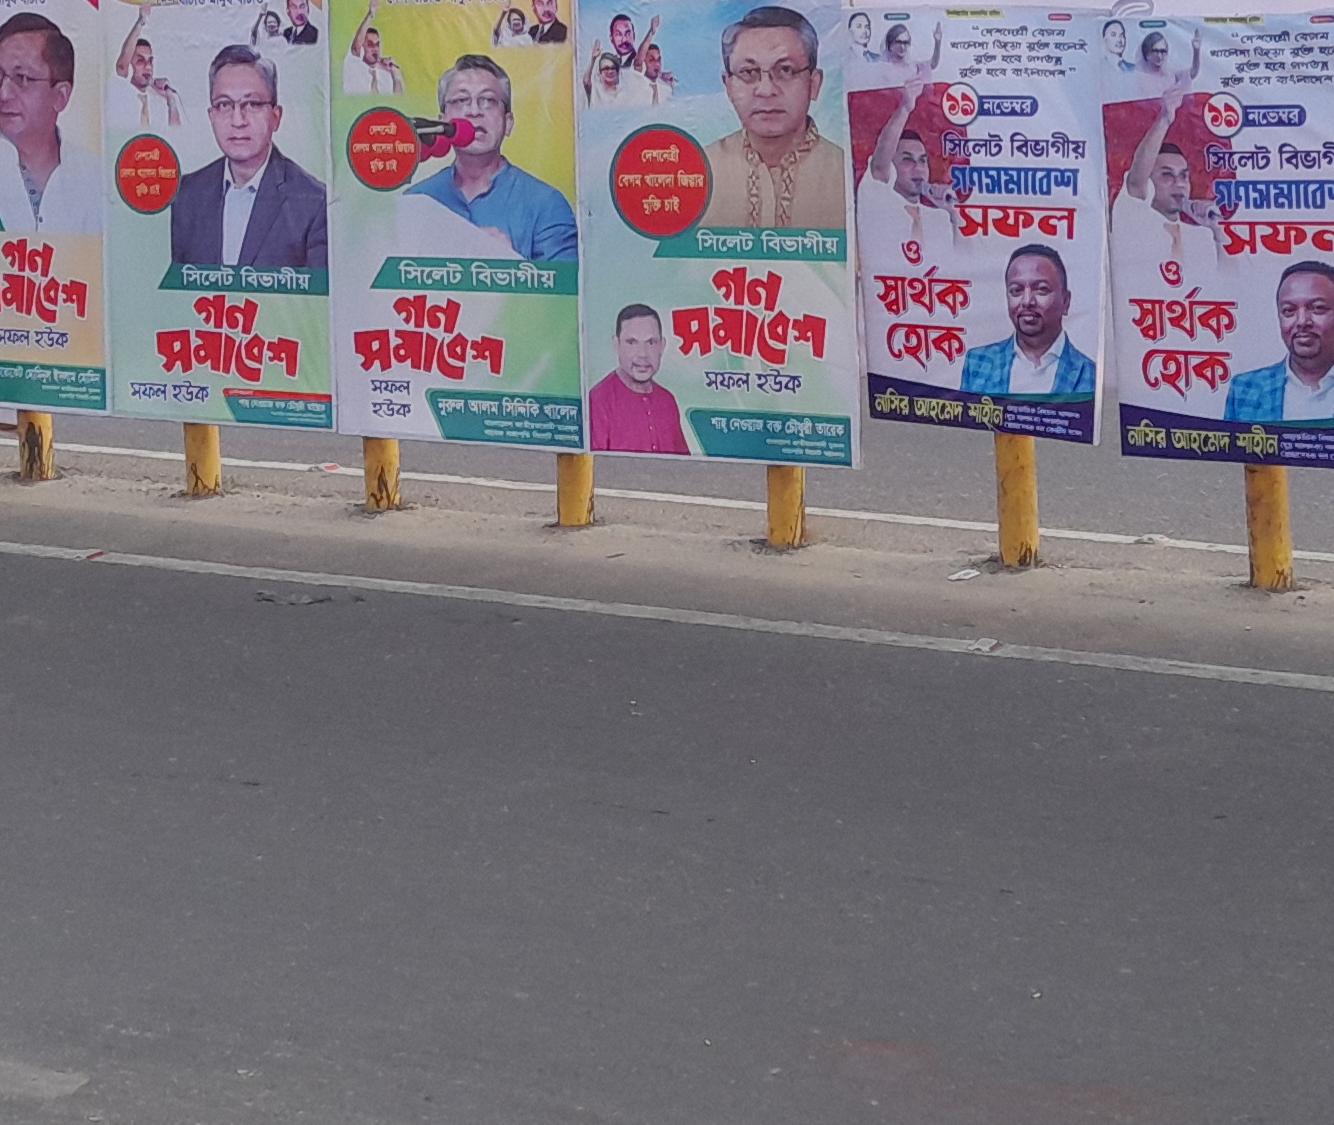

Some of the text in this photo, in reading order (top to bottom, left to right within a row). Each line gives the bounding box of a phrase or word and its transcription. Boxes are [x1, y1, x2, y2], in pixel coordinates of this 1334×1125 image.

[945, 92, 1033, 116] ১৯ নভেম্বর
[1208, 103, 1300, 127] ১৯ নভেম্বর
[942, 132, 1087, 159] সিলেট বিভাগীয়
[1205, 143, 1271, 171] সিলেট
[951, 166, 1079, 195] গণসমাবেশ
[954, 205, 1076, 239] সফল
[697, 230, 838, 256] সিলেট বিভাগীয়
[902, 240, 922, 265] ও
[182, 265, 310, 291] সিলেট বিভাগীয়
[398, 261, 555, 290] সিলেট বিভাগীয়
[1160, 260, 1183, 287] ও
[874, 266, 971, 317] স্বার্থক
[393, 293, 461, 334] গণ
[35, 327, 69, 348] হউক
[887, 323, 966, 371] হোক
[354, 329, 505, 380] সমাবেশ
[130, 381, 210, 403] সফল হউক
[371, 380, 410, 397] সফল
[705, 370, 801, 394] সফল হউক
[371, 399, 411, 419] হউক
[874, 388, 909, 414] নাসির
[914, 398, 964, 422] আহমেদ
[968, 397, 1003, 428] শাহীন
